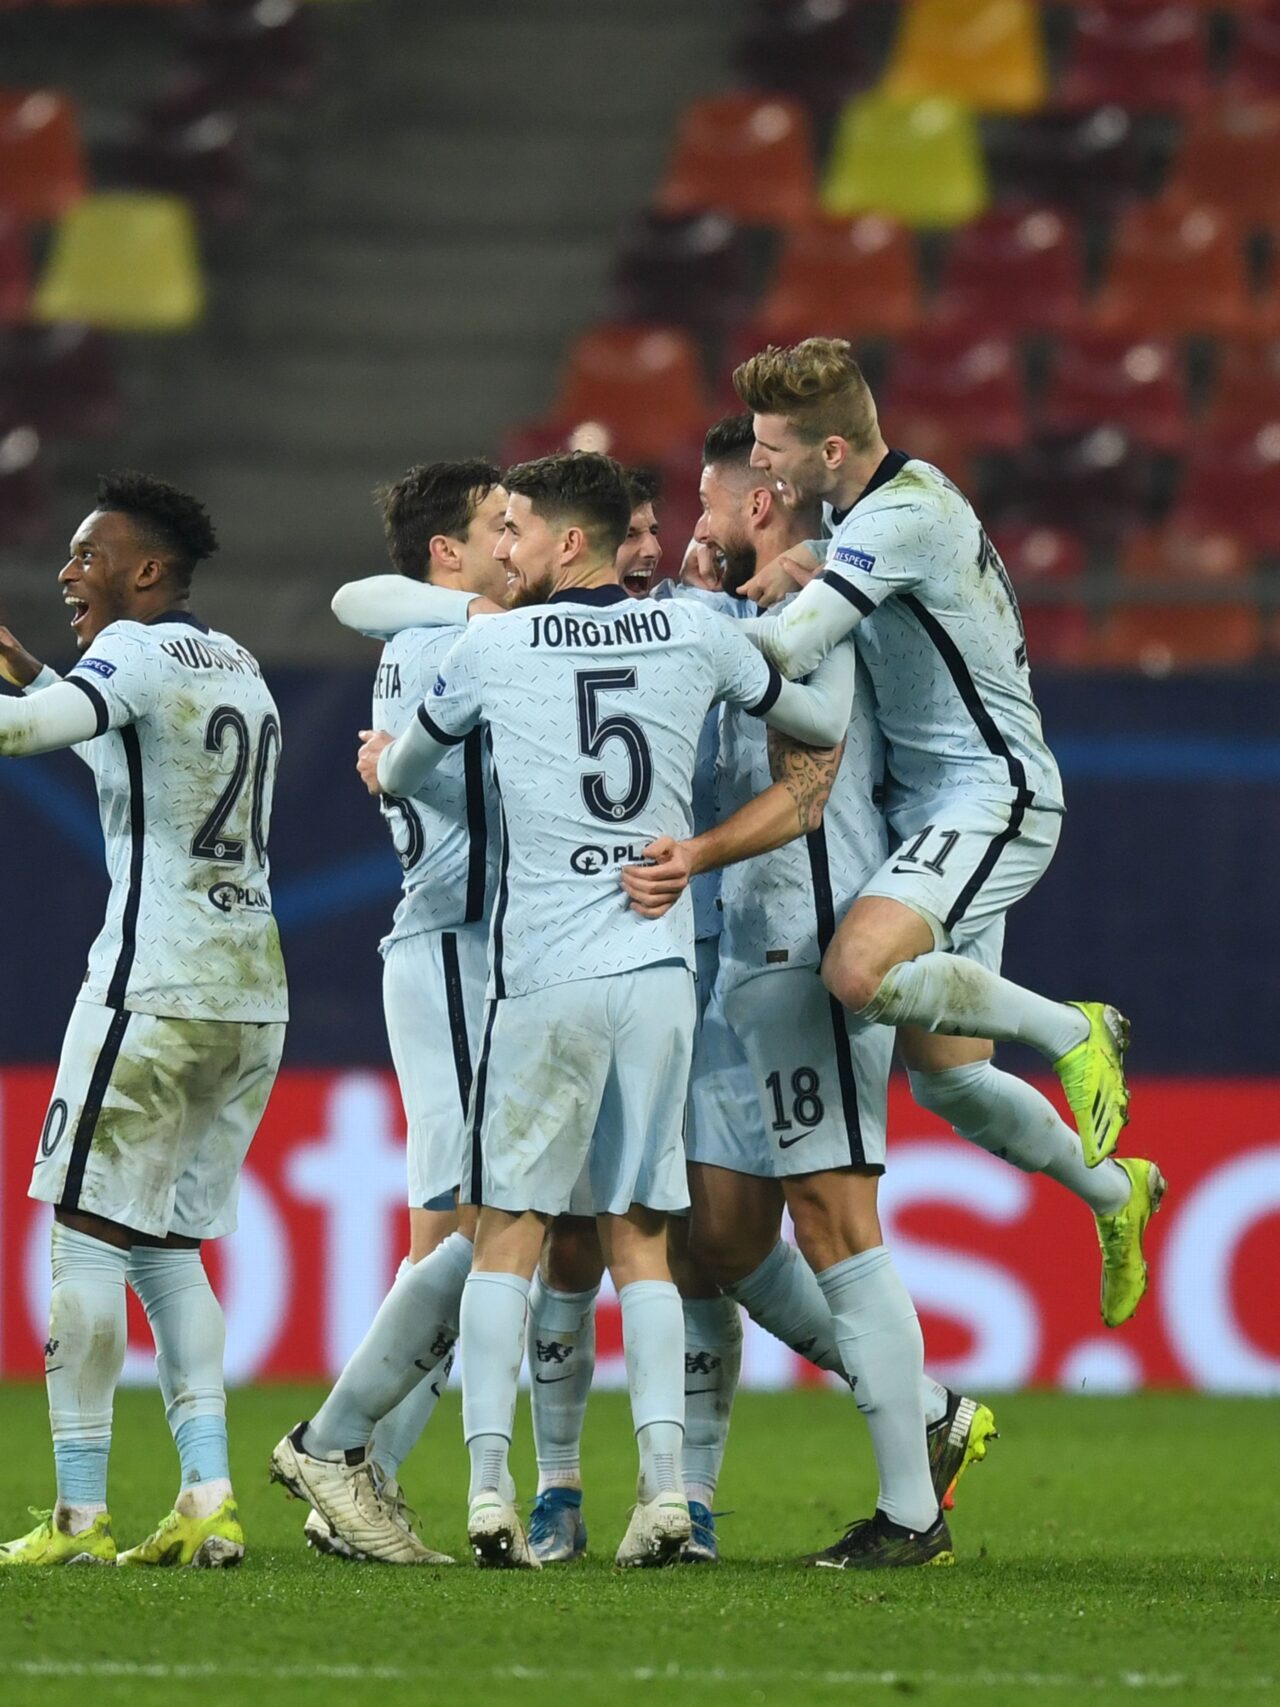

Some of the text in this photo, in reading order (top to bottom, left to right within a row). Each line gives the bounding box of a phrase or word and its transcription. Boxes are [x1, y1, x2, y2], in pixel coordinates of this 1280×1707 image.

[530, 609, 672, 649] JORGINHO
[80, 659, 113, 675] ESPECT
[160, 636, 262, 678] HUDSON-O
[573, 665, 654, 824] 5
[189, 704, 282, 869] 20
[897, 825, 960, 877] 11
[765, 1066, 824, 1131] 18
